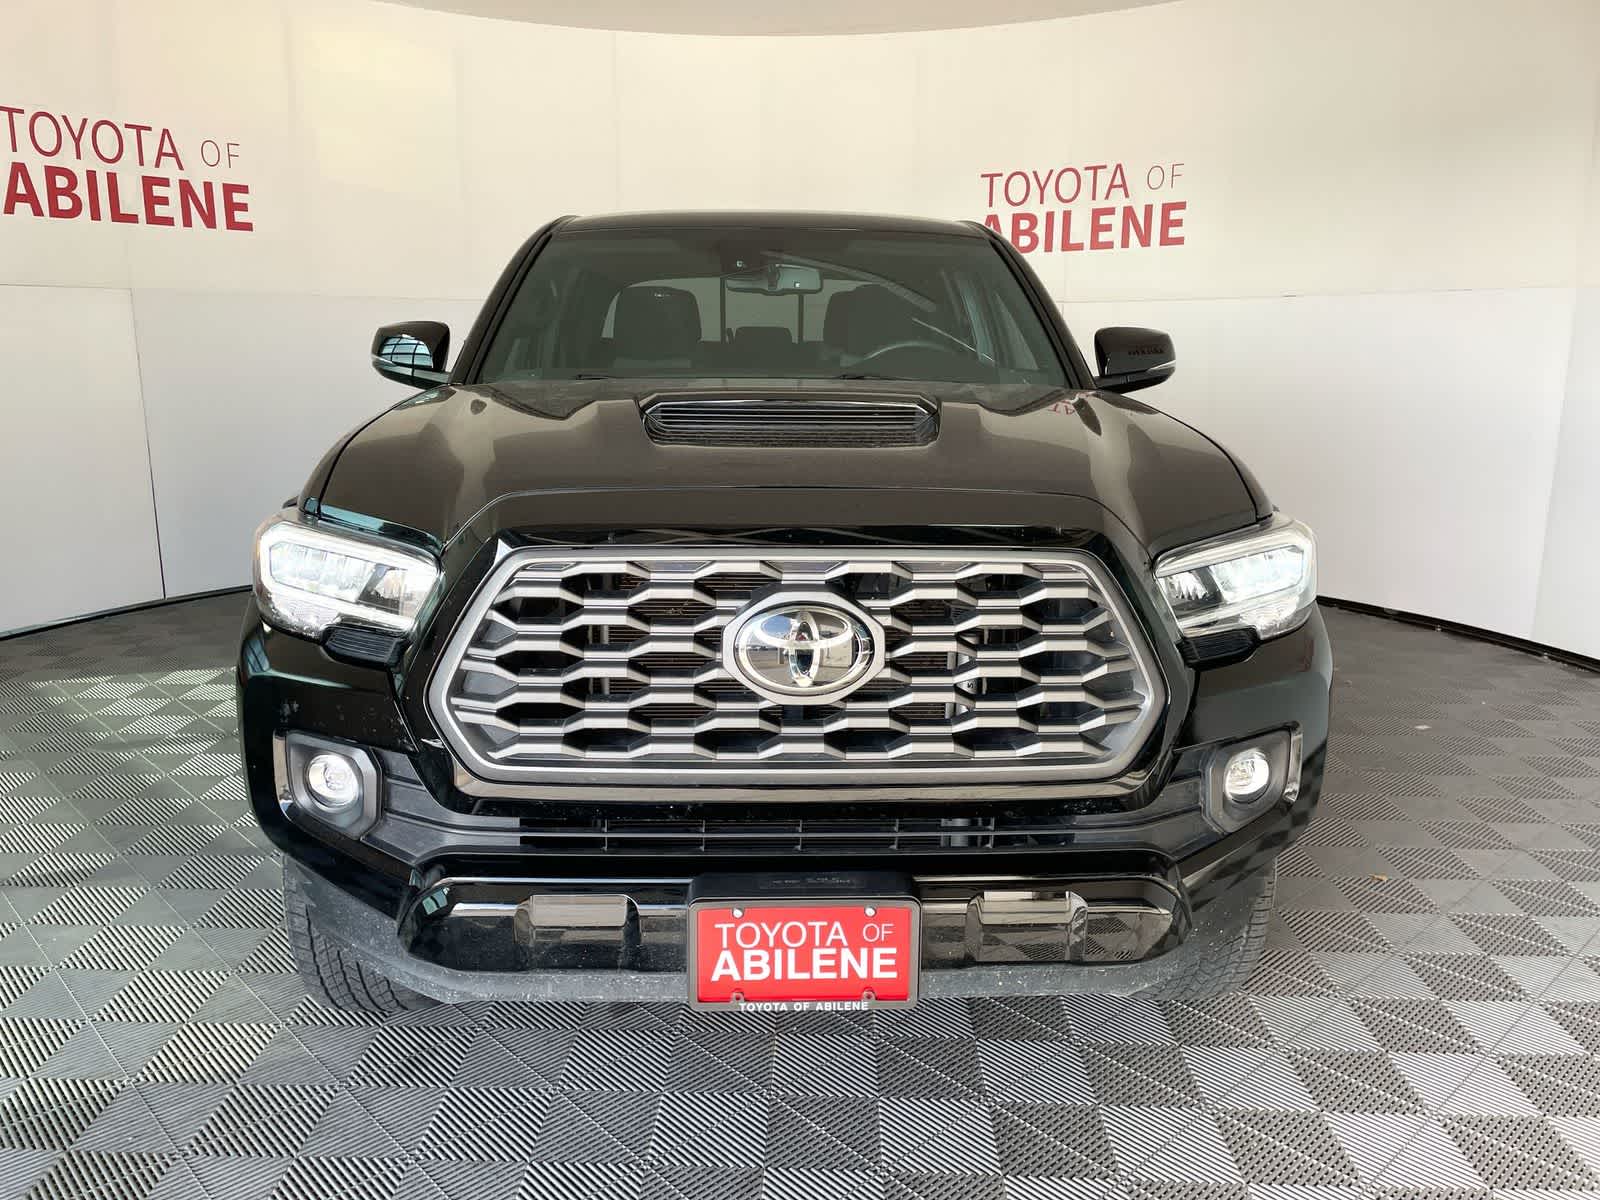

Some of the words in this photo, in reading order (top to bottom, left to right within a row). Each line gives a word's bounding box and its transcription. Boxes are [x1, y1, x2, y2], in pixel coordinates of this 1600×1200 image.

[0, 105, 185, 171] TOYOTA
[200, 139, 241, 169] OF
[3, 161, 254, 232] ABILENE
[980, 162, 1130, 208] TOYOTA
[1146, 162, 1185, 191] OF
[714, 920, 849, 949] TOYOTA
[862, 922, 895, 943] OF
[710, 947, 898, 982] ABILENE
[738, 1001, 788, 1012] TOYOTA
[793, 1001, 811, 1012] OF
[815, 1001, 870, 1012] ABILENE
